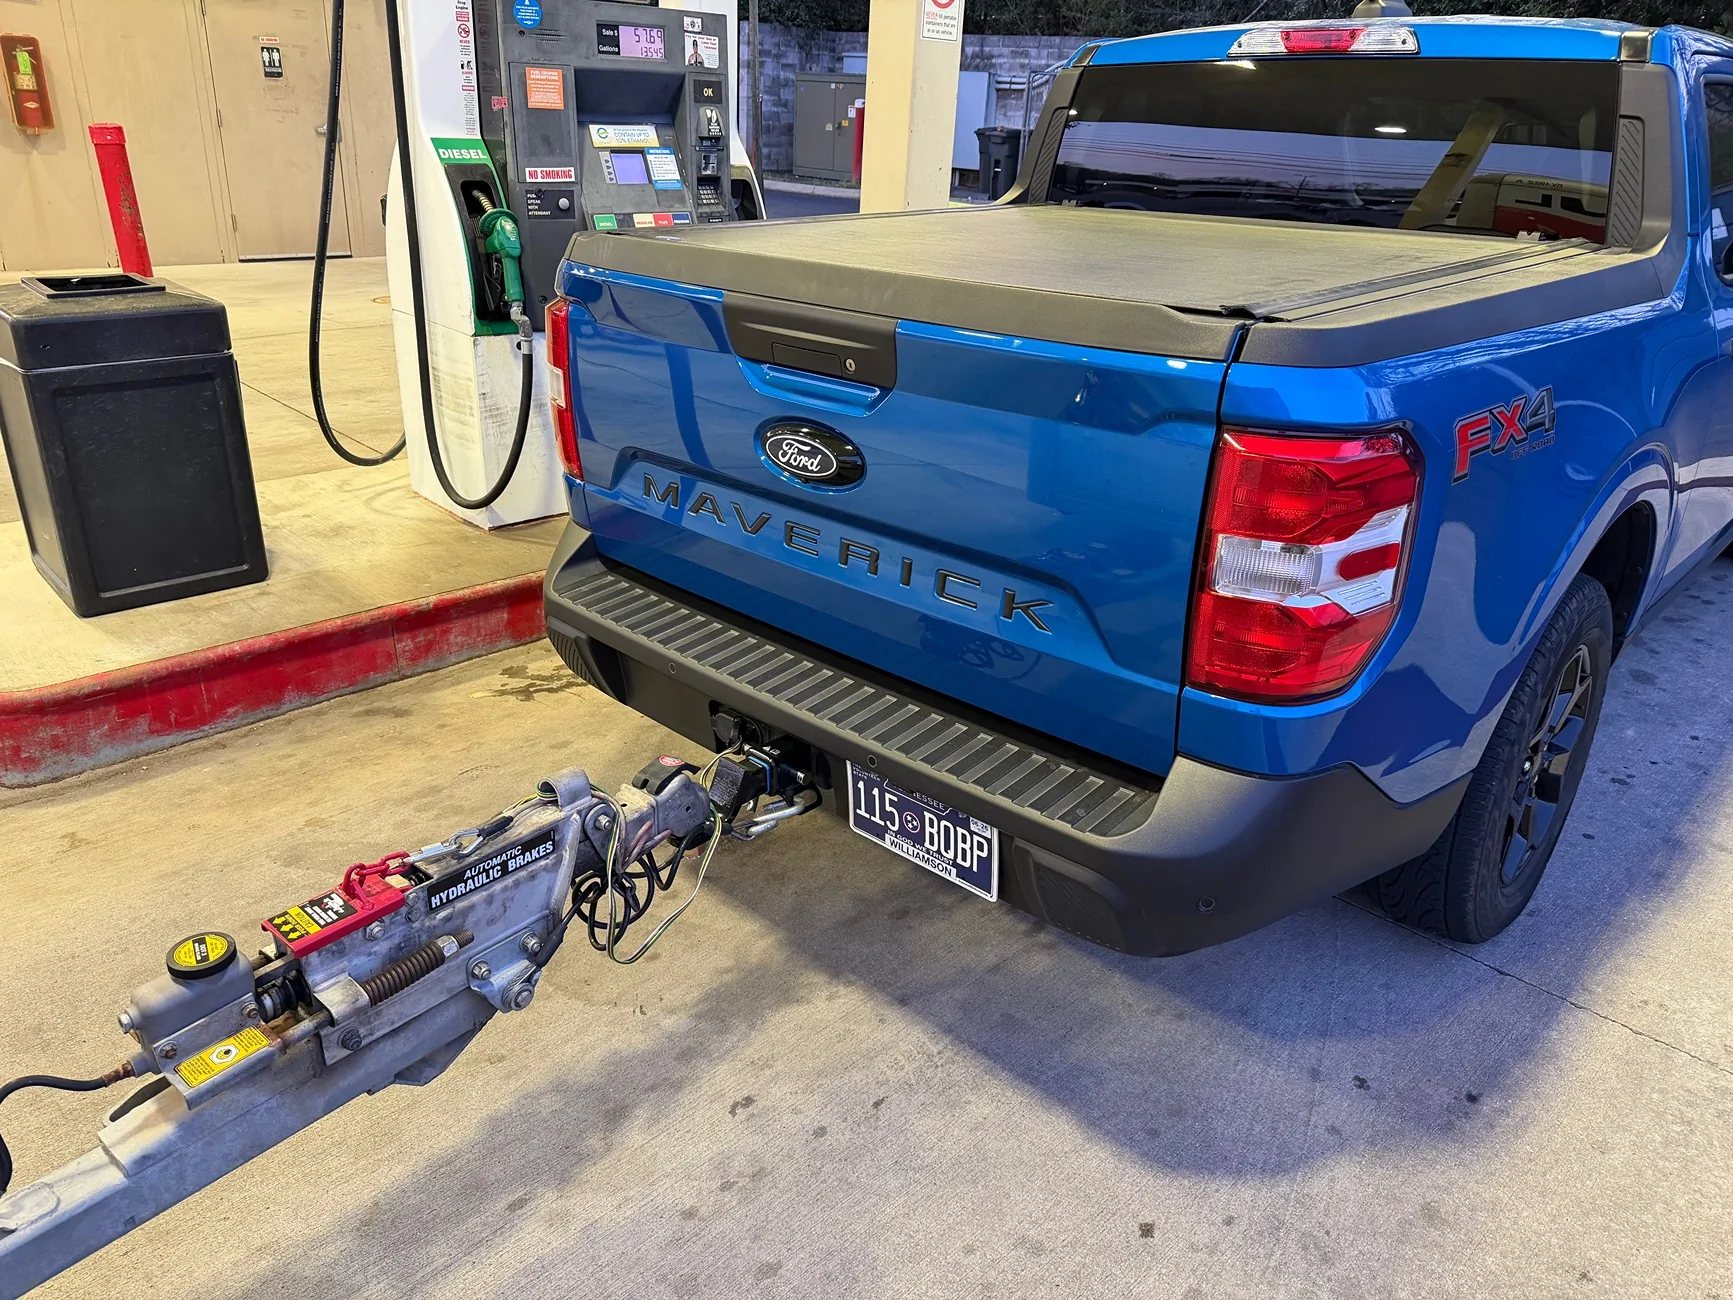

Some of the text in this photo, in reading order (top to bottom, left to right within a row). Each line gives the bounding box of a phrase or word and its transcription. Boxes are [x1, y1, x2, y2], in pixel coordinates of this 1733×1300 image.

[602, 28, 614, 36] Sale
[703, 88, 713, 96] OK
[438, 148, 487, 159] DIESEL
[528, 169, 572, 179] NO SMOKING
[1452, 385, 1556, 486] FX4
[1511, 435, 1555, 460] OFF ROAD
[779, 440, 822, 471] Ford
[643, 472, 1054, 635] MAVERICK
[856, 780, 988, 872] 115 BQBP
[464, 846, 522, 880] AUTOMATIC
[889, 837, 952, 876] WILLIAMSON
[897, 834, 913, 845] GOD
[915, 843, 927, 853] WE
[929, 850, 953, 865] TRUST
[431, 841, 554, 908] HYDRAULIC BRAKES
